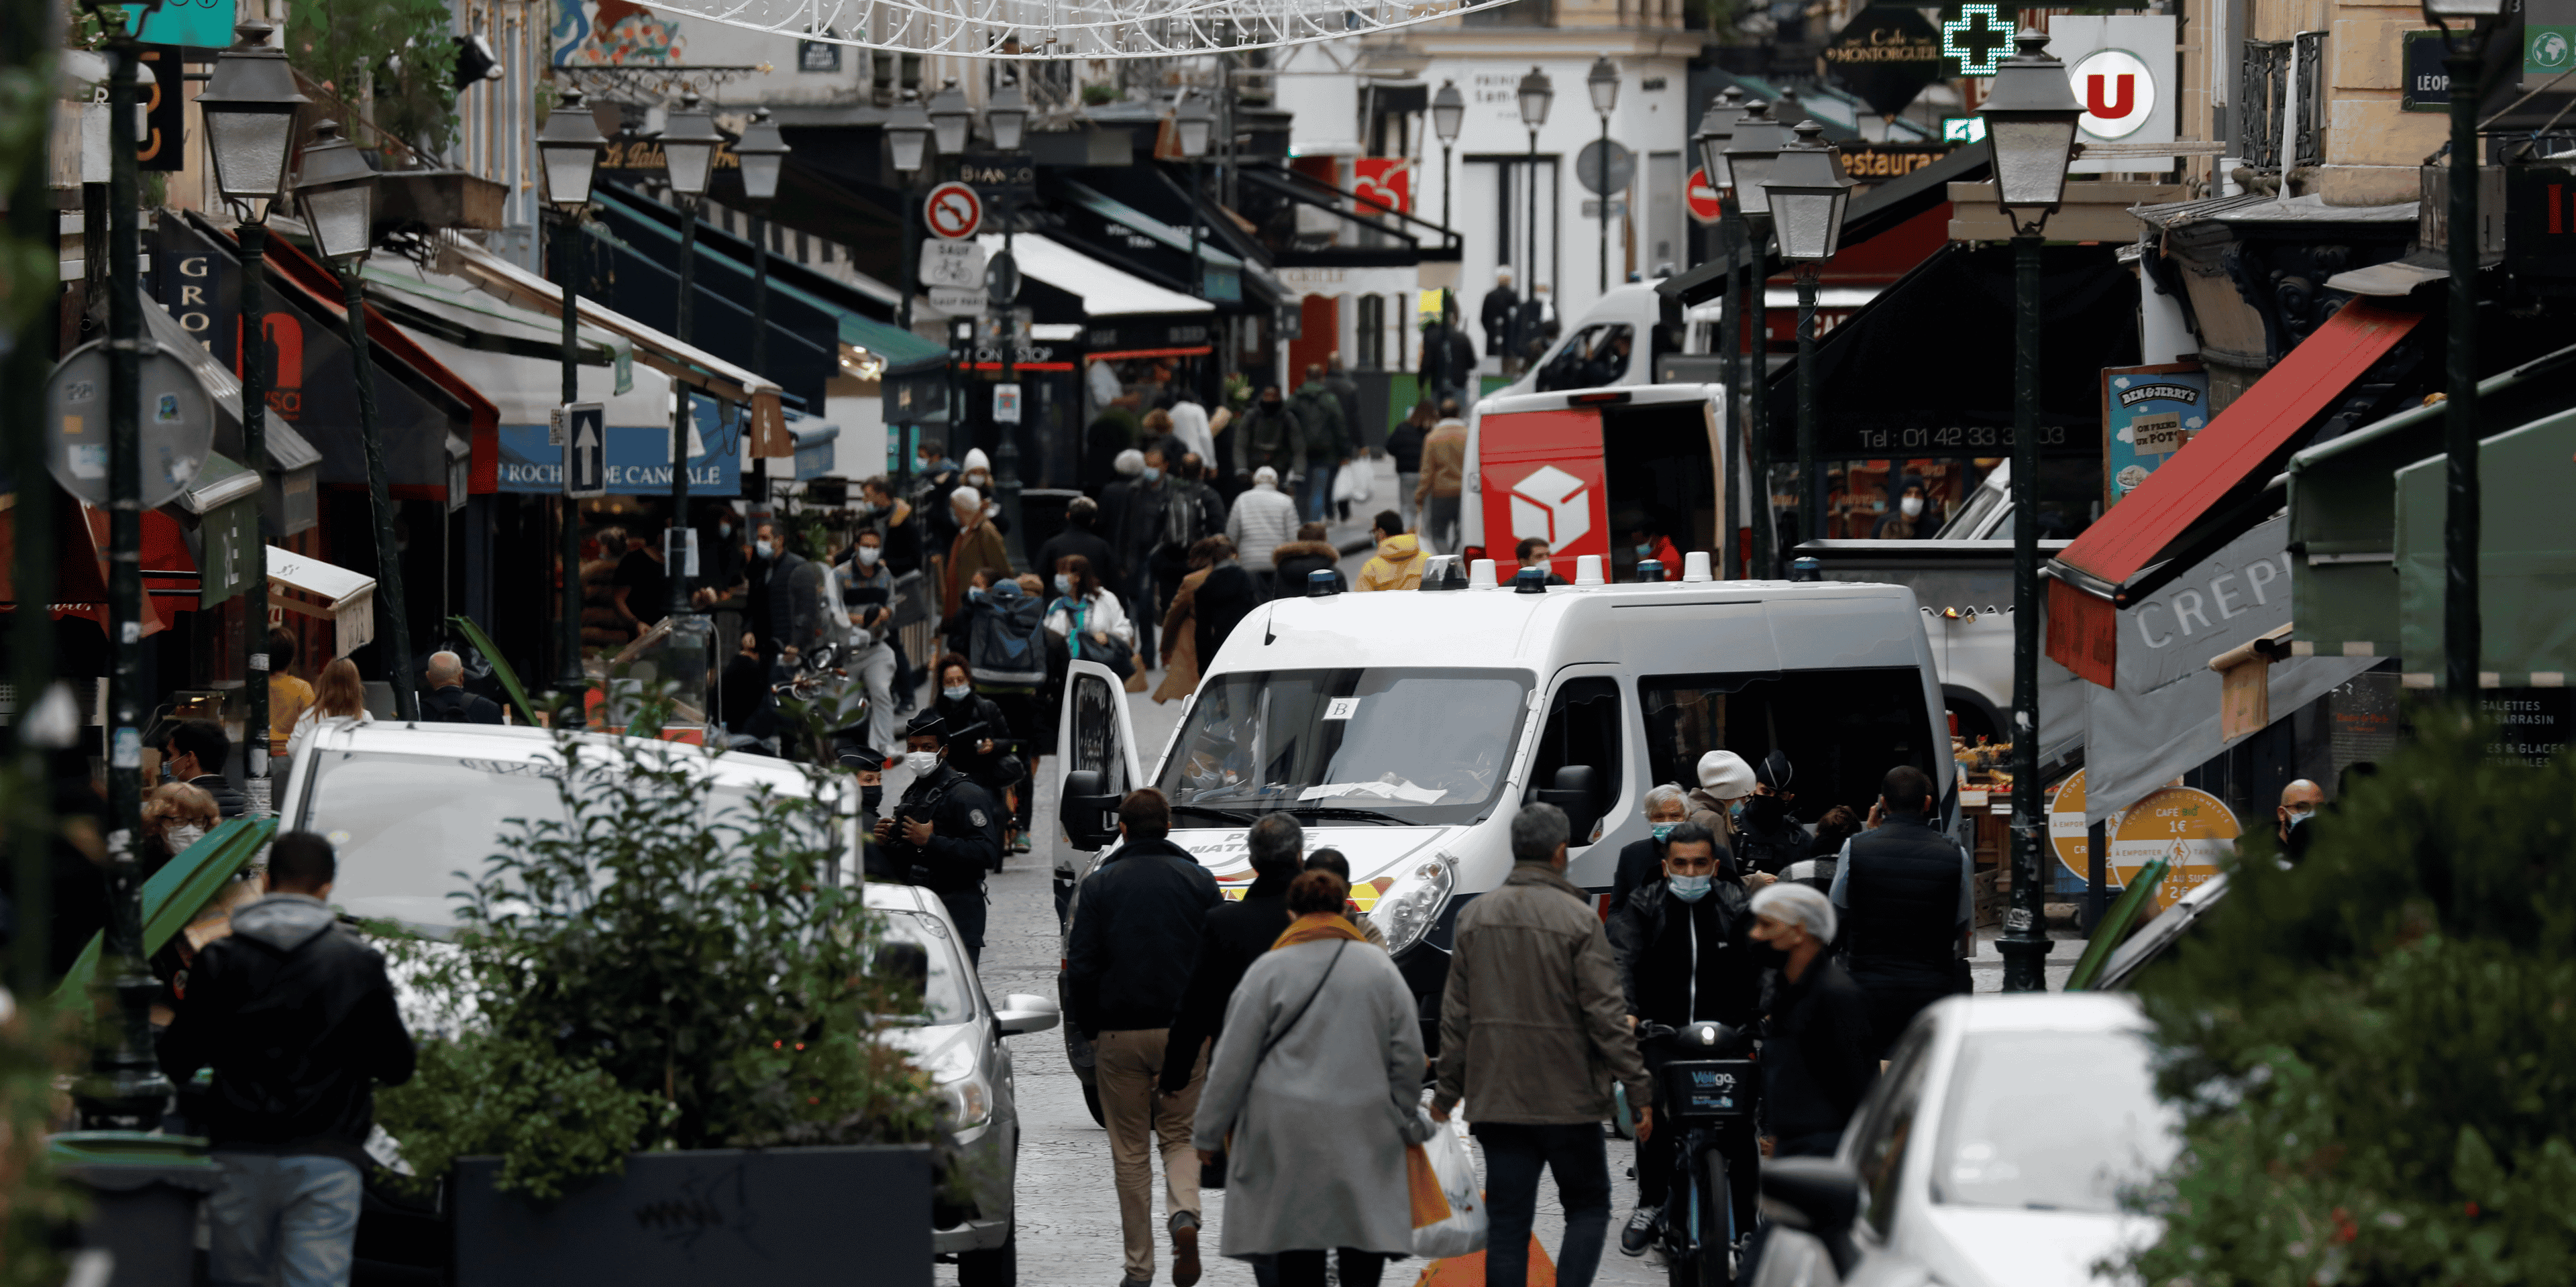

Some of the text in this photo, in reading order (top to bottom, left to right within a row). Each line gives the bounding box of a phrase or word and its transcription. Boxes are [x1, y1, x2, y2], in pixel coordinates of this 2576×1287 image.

[2417, 72, 2450, 91] LÉOP
[2087, 74, 2135, 119] U
[960, 164, 1033, 183] BIANO
[1016, 346, 1054, 363] STOP
[2151, 421, 2178, 431] PREND
[1859, 429, 1886, 447] Tel
[1903, 429, 1927, 447] 01
[1934, 427, 1962, 446] 42
[1968, 427, 1996, 445] 33
[508, 465, 564, 483] ROCH
[1332, 703, 1348, 715] B
[2481, 700, 2541, 711] GALETTES
[2495, 715, 2555, 724] SARRASIN
[2519, 743, 2566, 753] GLACES
[2155, 805, 2180, 818] CAFÉ
[2169, 820, 2187, 832] 1€
